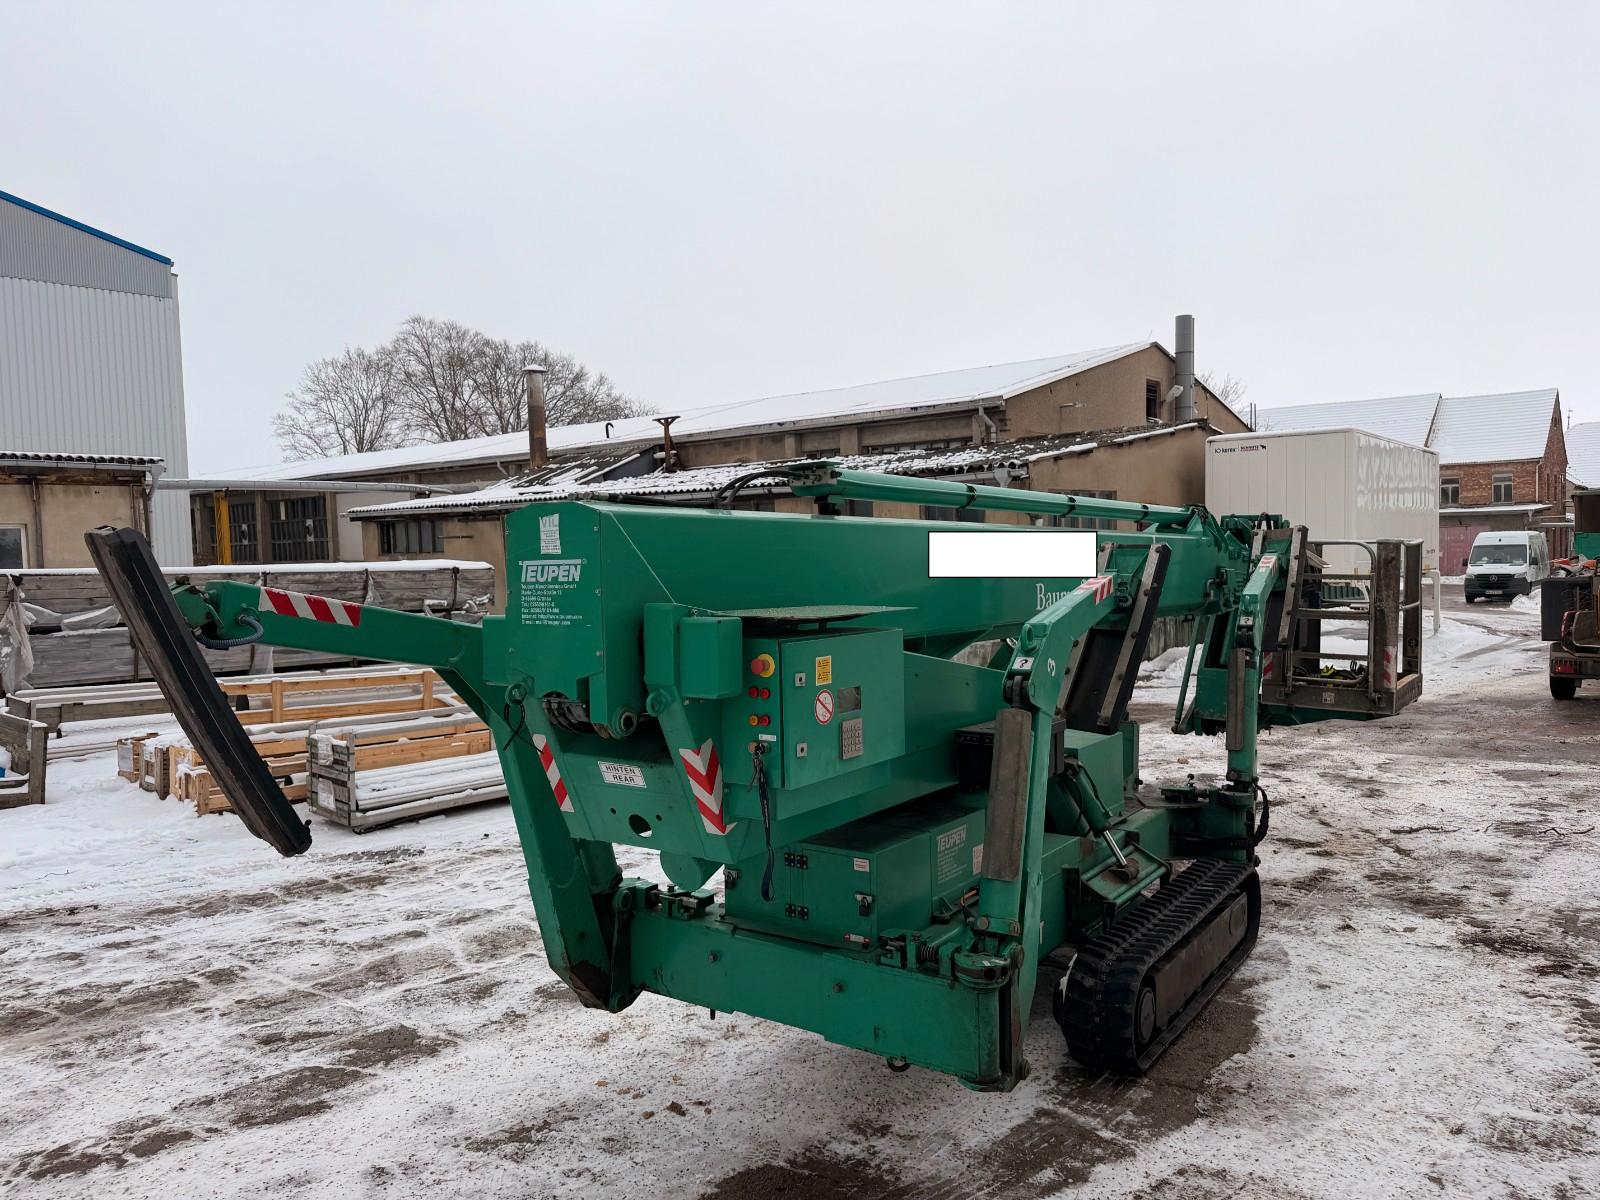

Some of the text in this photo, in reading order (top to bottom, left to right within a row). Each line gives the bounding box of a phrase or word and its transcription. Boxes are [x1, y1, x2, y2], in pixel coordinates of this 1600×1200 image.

[519, 559, 581, 582] TEUPEN
[605, 765, 636, 774] HINTEN
[613, 774, 636, 783] REAR
[936, 824, 967, 852] TEUPEN
